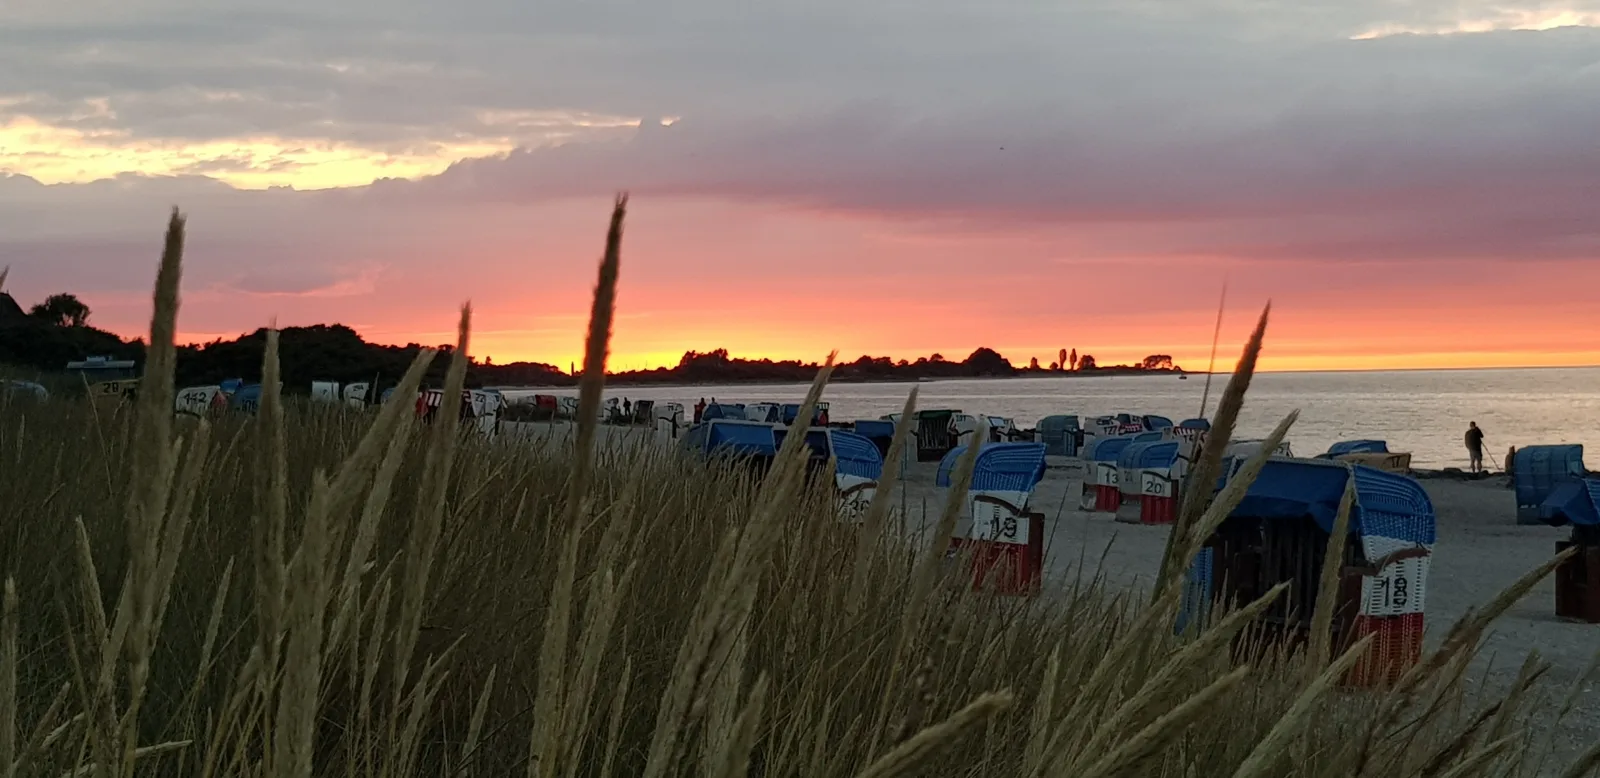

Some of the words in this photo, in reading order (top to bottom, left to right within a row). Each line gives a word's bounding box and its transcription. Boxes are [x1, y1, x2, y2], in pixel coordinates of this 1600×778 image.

[1105, 470, 1119, 484] 13
[1146, 481, 1162, 494] 20
[990, 517, 1017, 538] 19
